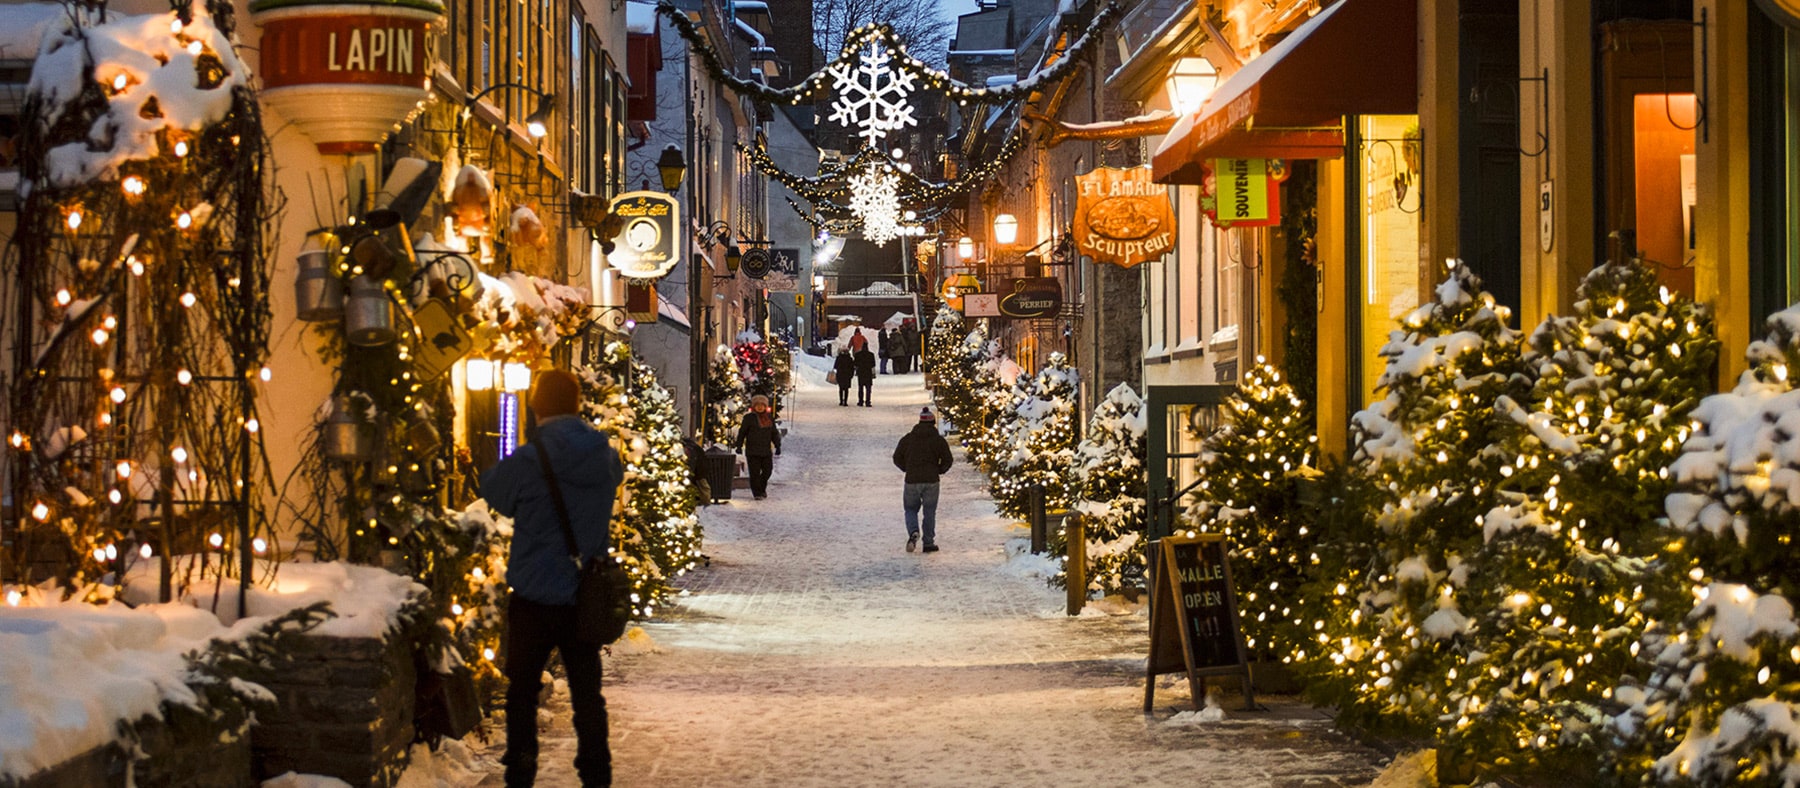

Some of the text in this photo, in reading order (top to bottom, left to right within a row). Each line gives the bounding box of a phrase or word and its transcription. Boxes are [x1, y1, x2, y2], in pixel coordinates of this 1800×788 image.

[328, 28, 413, 74] LAPIN
[1083, 233, 1170, 264] Sculpteur
[1177, 565, 1223, 583] MALLE
[1185, 591, 1222, 608] OPEN
